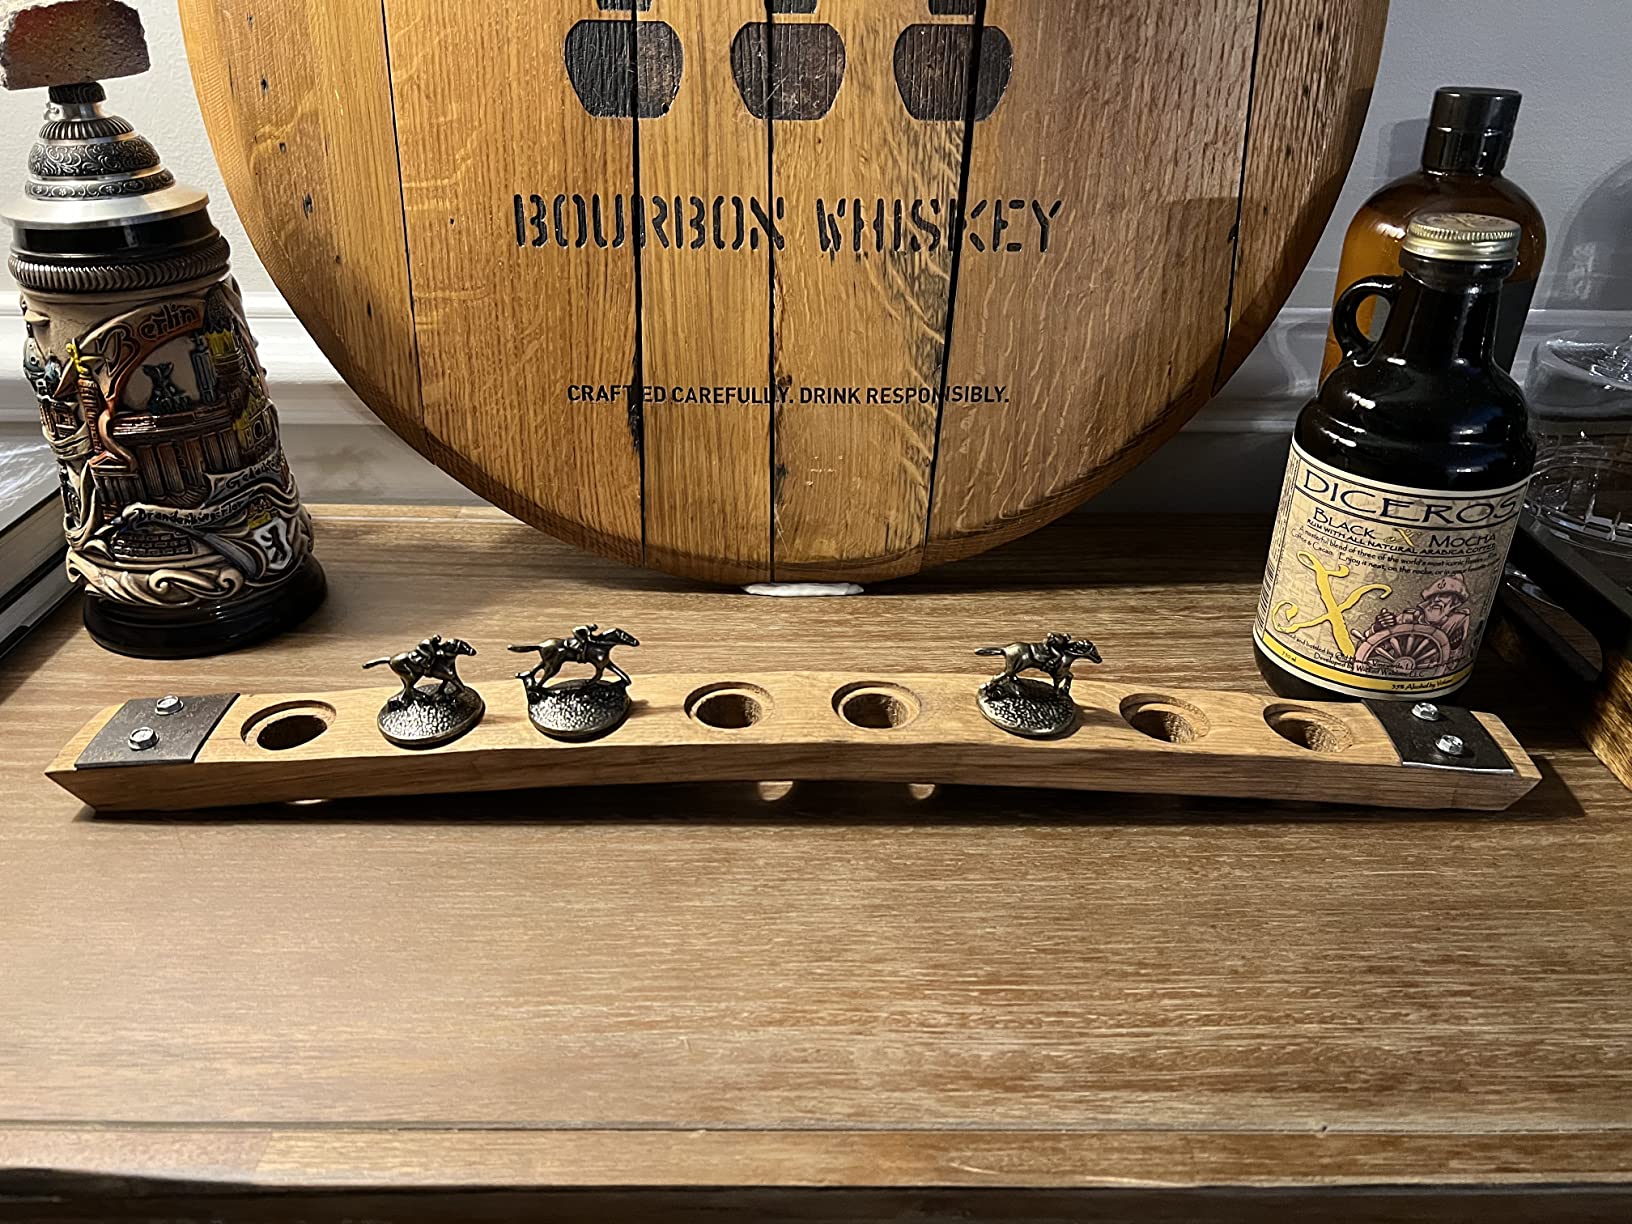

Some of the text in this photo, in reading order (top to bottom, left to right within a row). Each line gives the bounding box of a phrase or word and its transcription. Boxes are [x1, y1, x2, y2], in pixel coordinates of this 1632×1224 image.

[513, 194, 1062, 252] BOURBON WHISKEY
[100, 303, 198, 377] Berlin
[567, 384, 1010, 404] CRAFTED CAREFULLY. DRINK RESPONSIBLY.
[1303, 469, 1519, 524] DICEROS
[1307, 519, 1322, 530] RUM
[1323, 526, 1345, 539] WITH
[1347, 536, 1365, 545] ALL
[1368, 541, 1418, 554] NATURAL
[1330, 540, 1347, 551] blend
[1357, 549, 1376, 559] three
[1377, 553, 1385, 561] of
[1339, 552, 1361, 567] Enjoy
[1314, 652, 1347, 668] Developed
